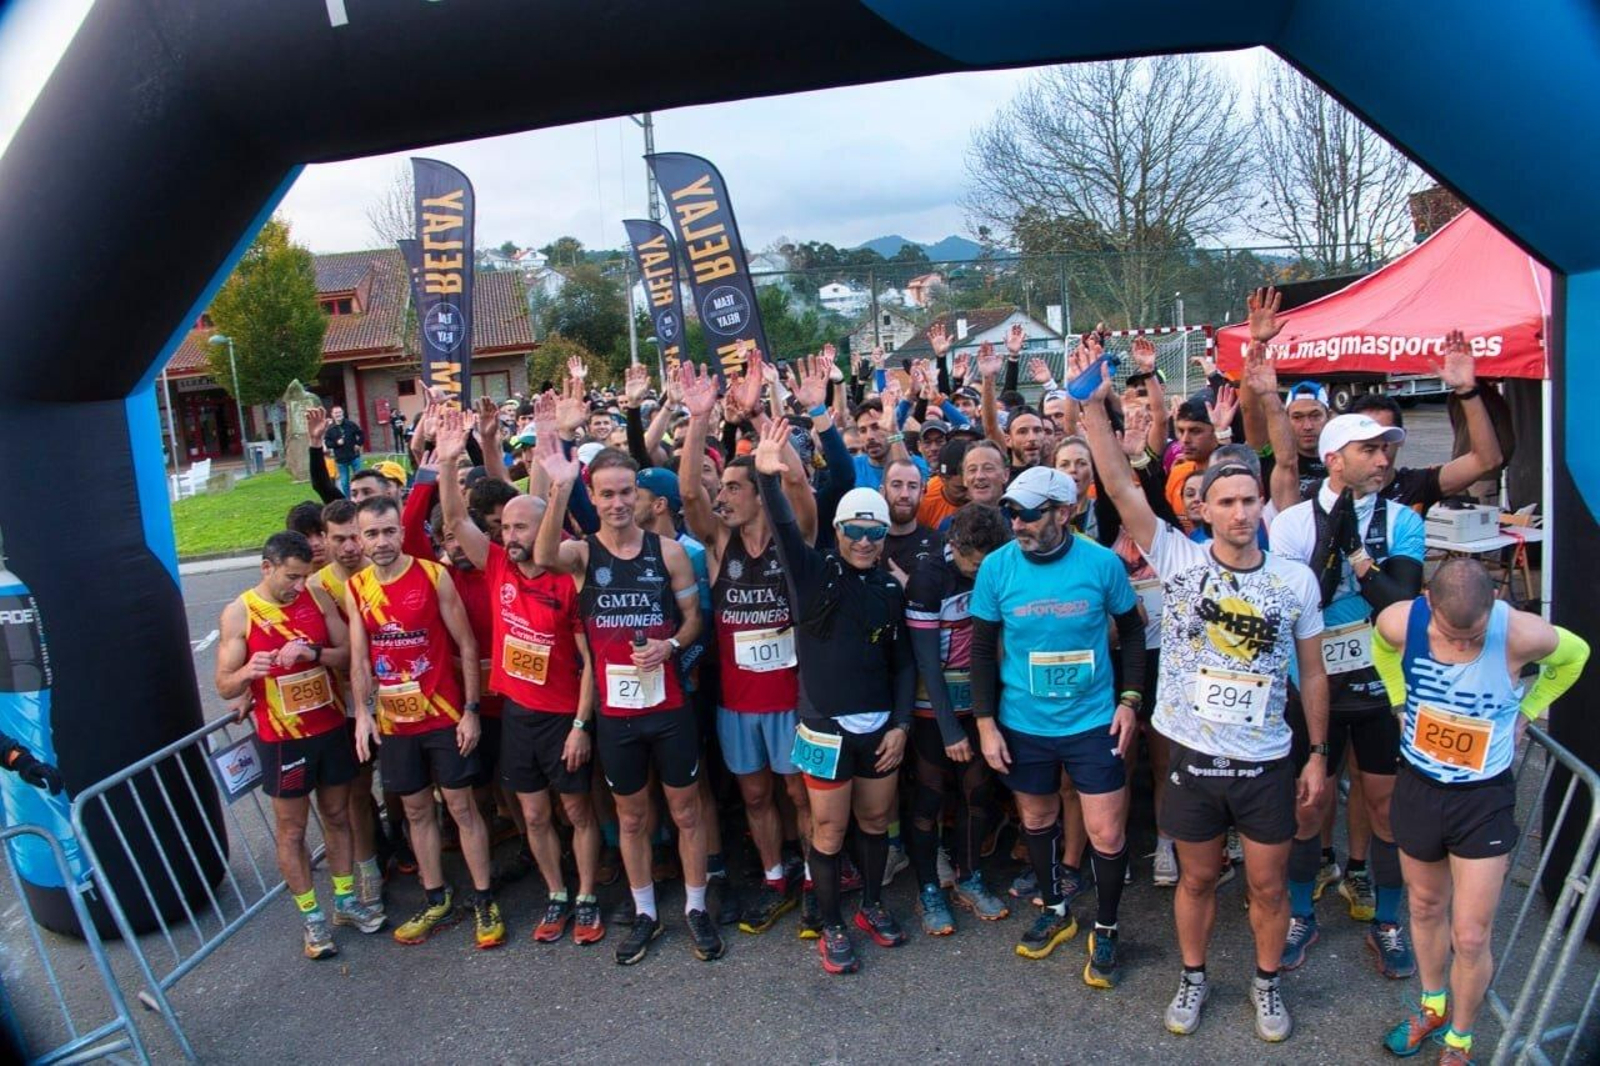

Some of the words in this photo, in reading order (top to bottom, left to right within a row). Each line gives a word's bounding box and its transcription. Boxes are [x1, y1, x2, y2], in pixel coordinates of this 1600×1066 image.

[597, 593, 651, 608] GMTA
[651, 602, 661, 612] &
[726, 588, 776, 604] GMTA
[596, 613, 664, 628] CHUVONERS
[721, 608, 790, 624] CHUVONERS
[749, 643, 780, 662] 101
[1323, 639, 1362, 662] 278
[512, 651, 545, 672] 226
[1044, 667, 1079, 686] 122
[291, 680, 323, 702] 259
[1207, 684, 1253, 709] 294
[389, 697, 419, 713] 183
[1426, 723, 1474, 753] 250
